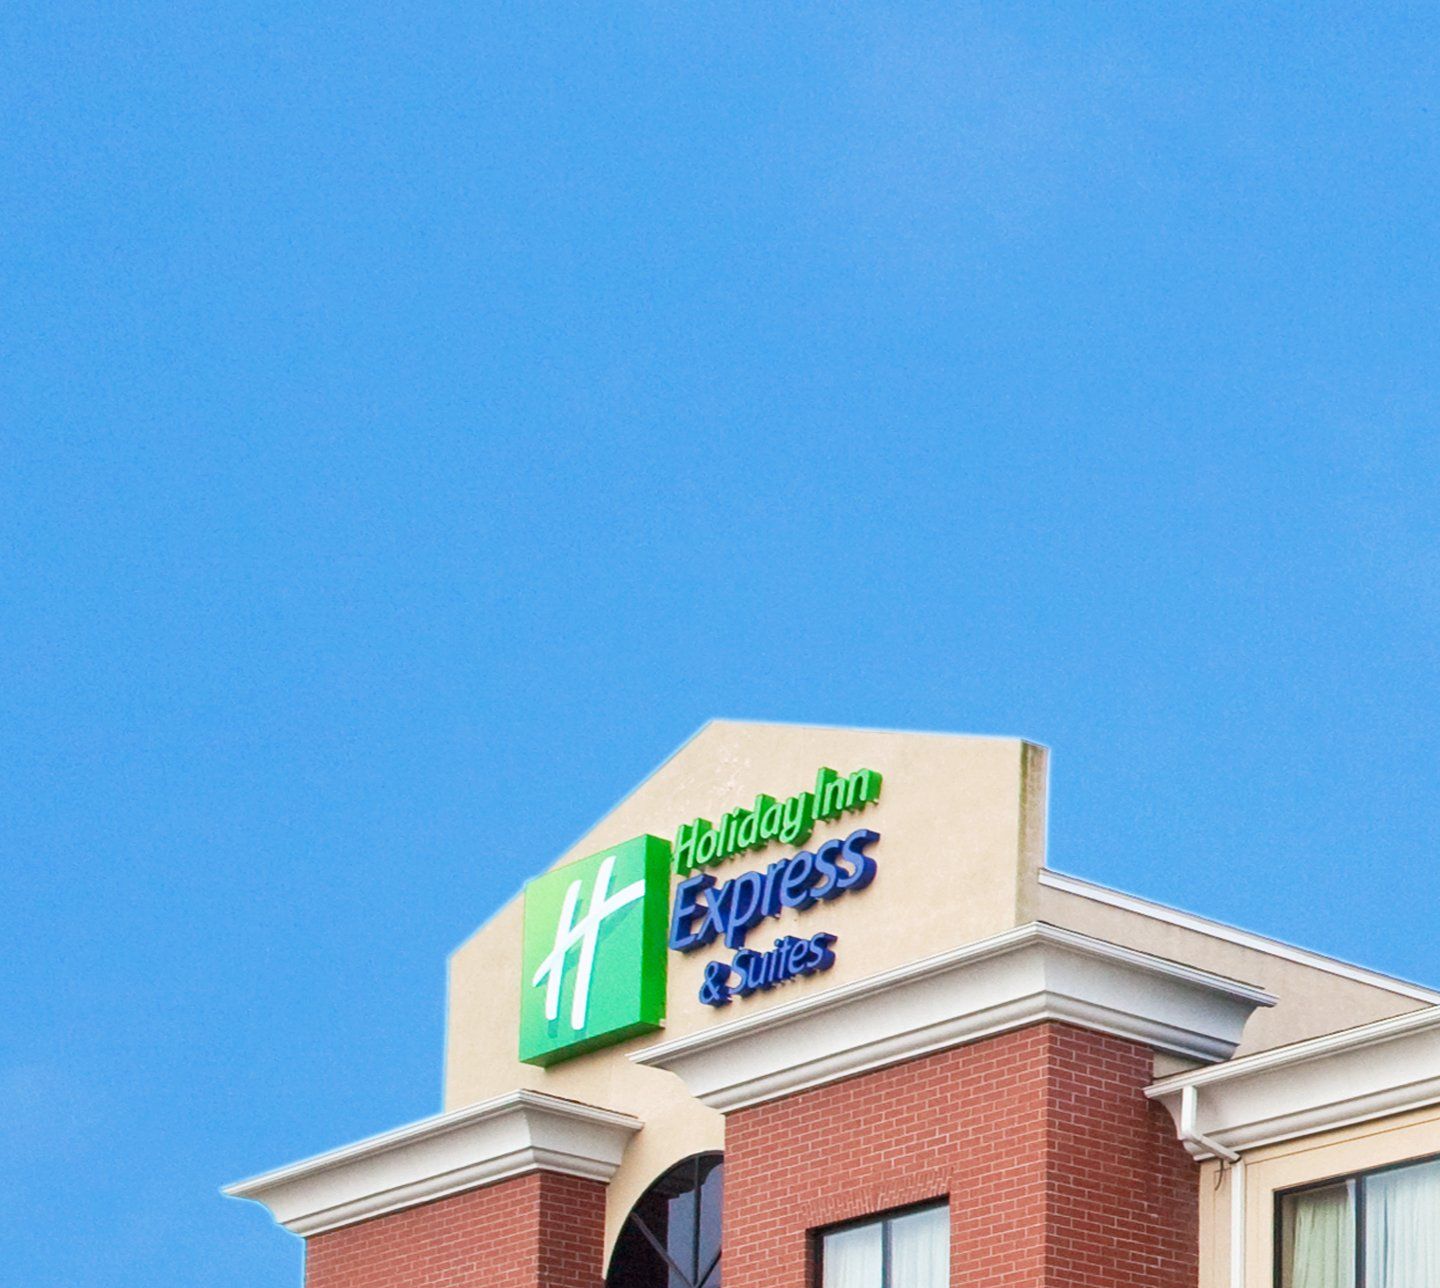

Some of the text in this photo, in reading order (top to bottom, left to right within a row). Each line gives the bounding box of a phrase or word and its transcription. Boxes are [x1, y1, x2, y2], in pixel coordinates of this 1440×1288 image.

[673, 767, 882, 875] Holiday Inn
[669, 828, 880, 951] Express
[699, 932, 837, 1007] & Suites
